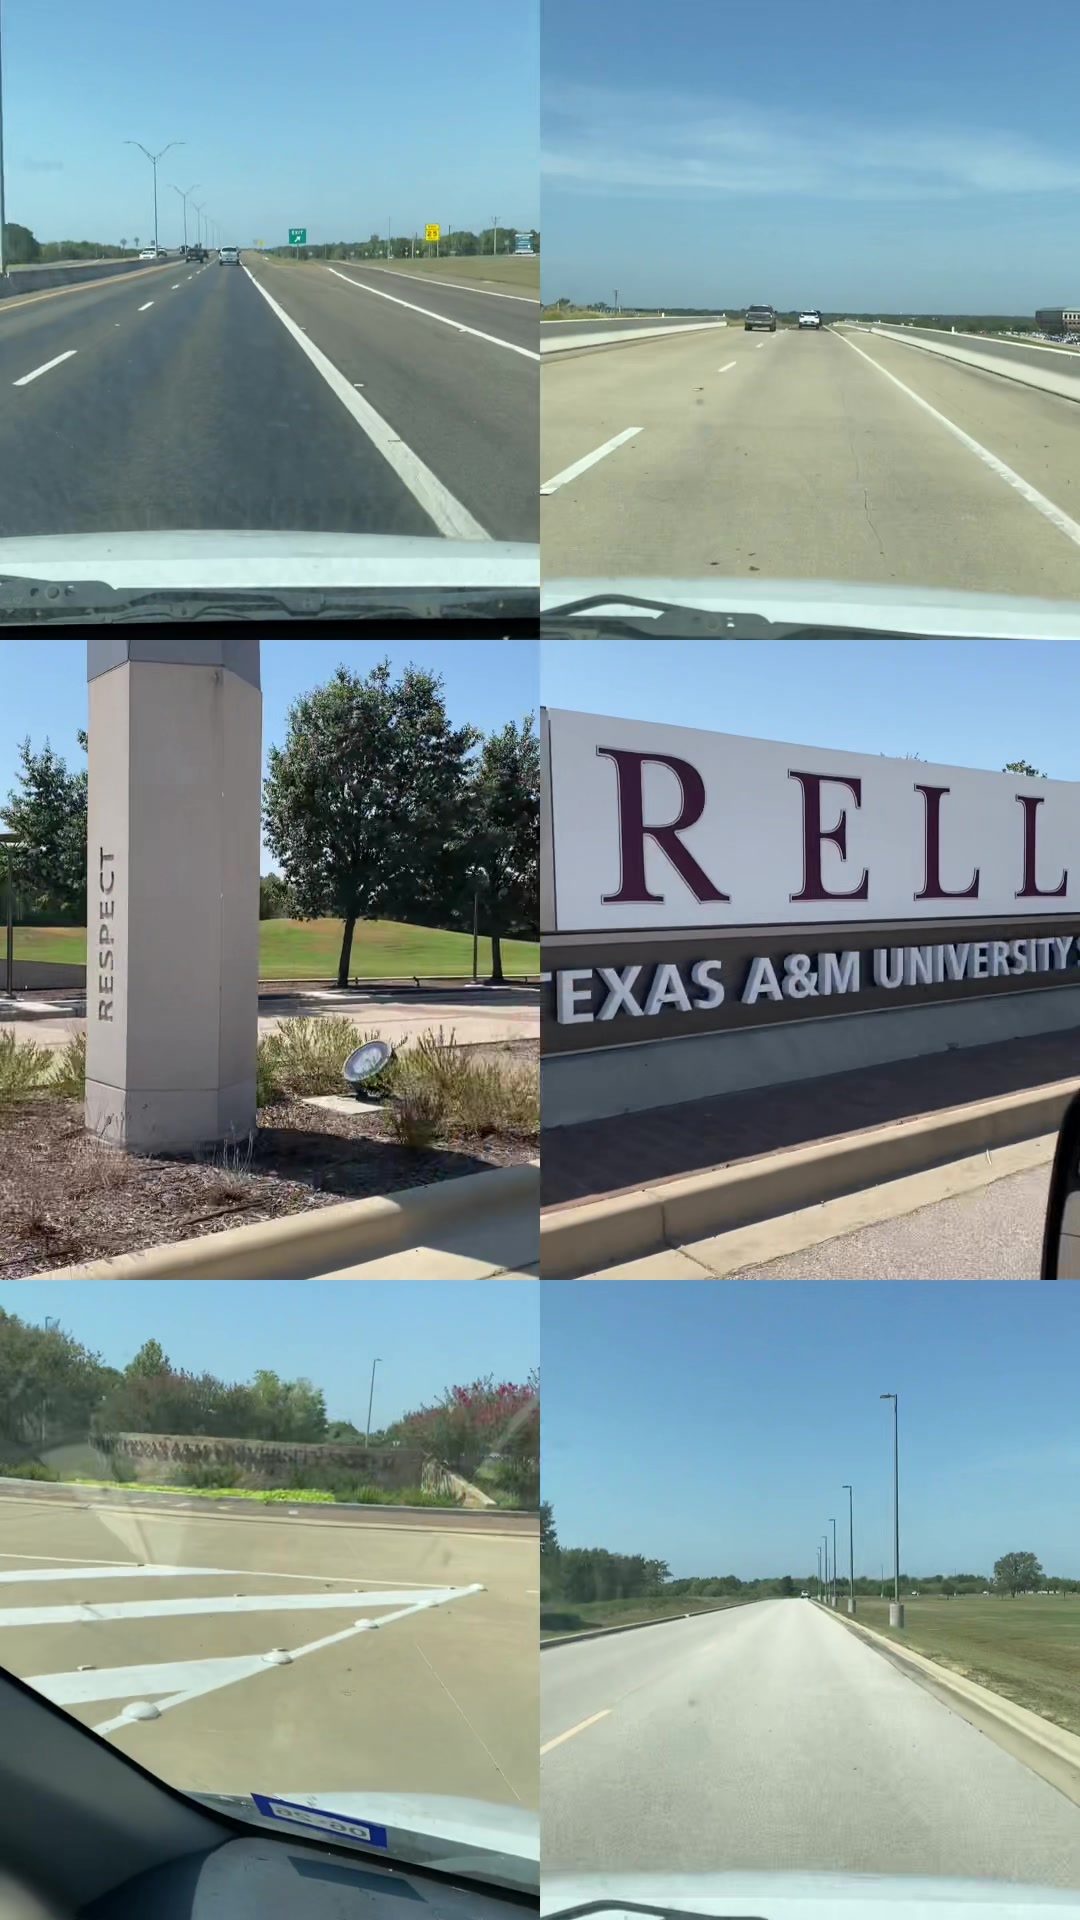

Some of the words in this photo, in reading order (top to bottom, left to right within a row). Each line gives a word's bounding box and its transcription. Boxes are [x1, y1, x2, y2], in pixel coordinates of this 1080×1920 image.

[98, 846, 114, 1022] RESPECT
[741, 951, 860, 1004] A&M
[873, 936, 1074, 989] UNIVERSITY
